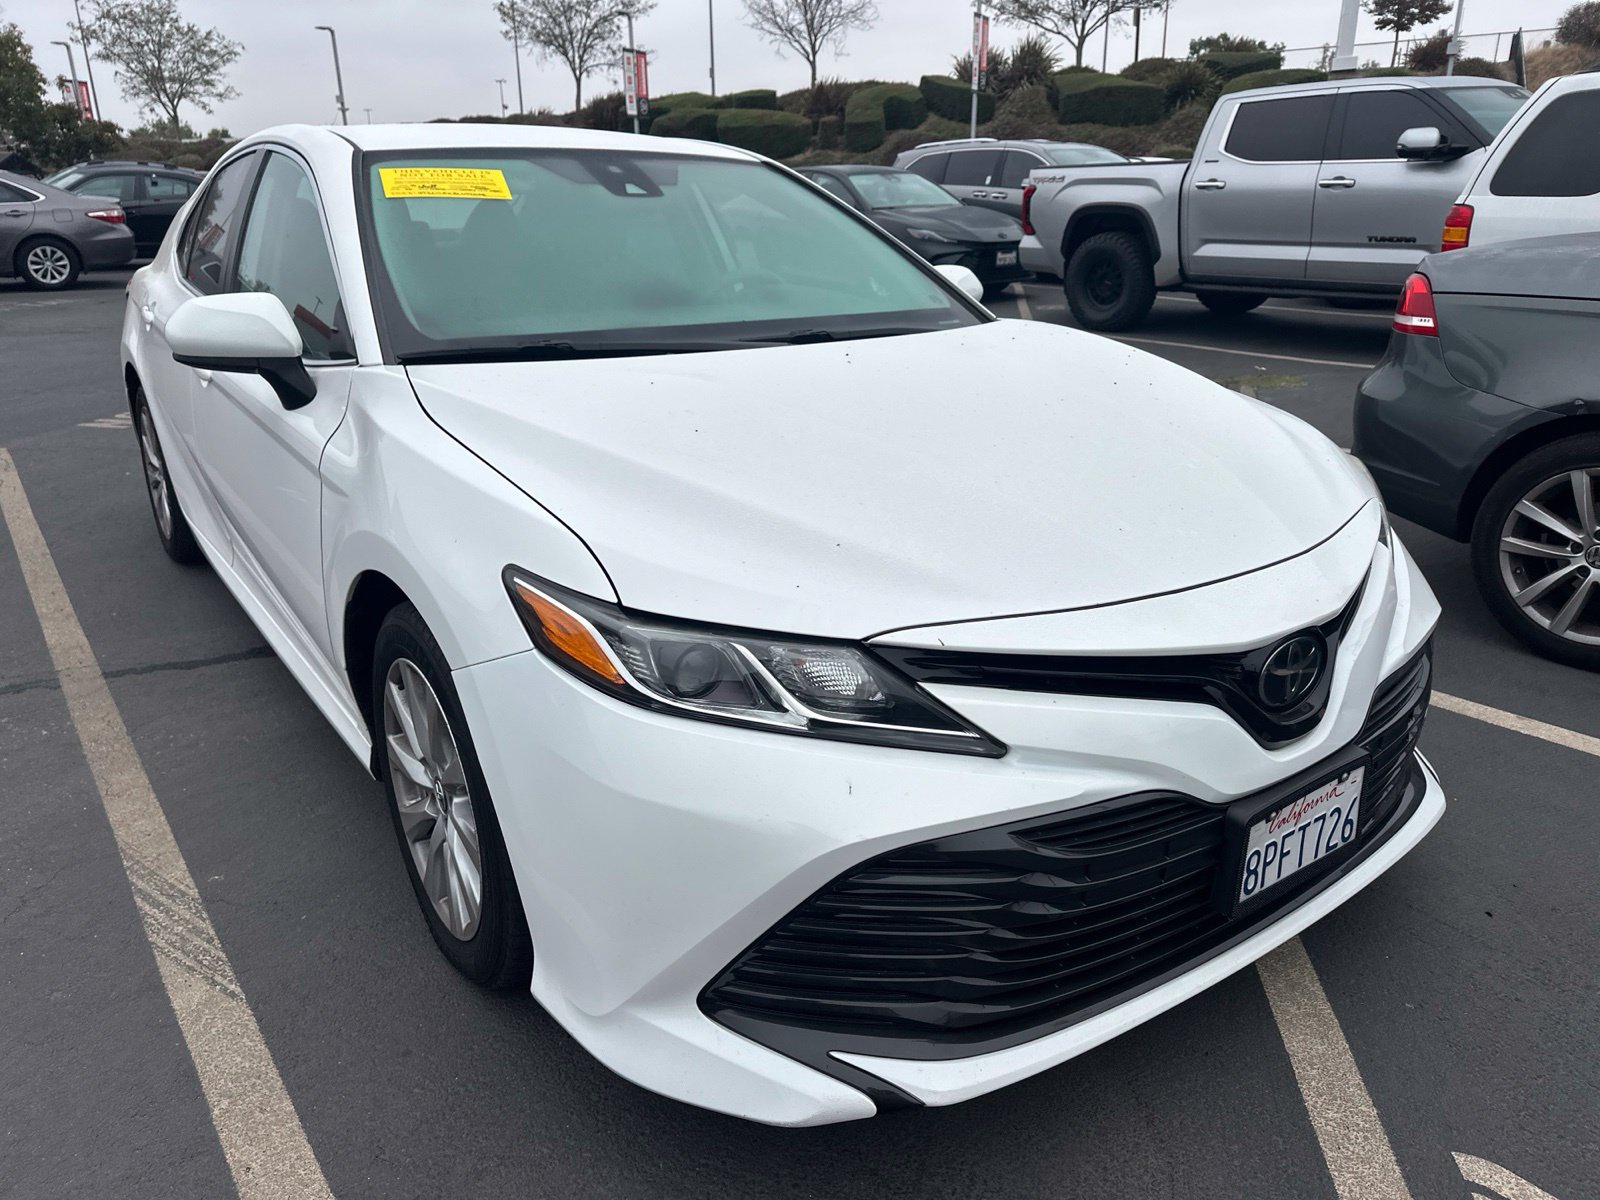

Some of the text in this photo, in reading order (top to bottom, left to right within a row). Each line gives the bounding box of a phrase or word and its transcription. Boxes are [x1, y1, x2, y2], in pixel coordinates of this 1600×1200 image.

[1366, 235, 1417, 244] TUNDRA
[1268, 783, 1345, 834] California
[1243, 796, 1358, 896] 8PFT726
